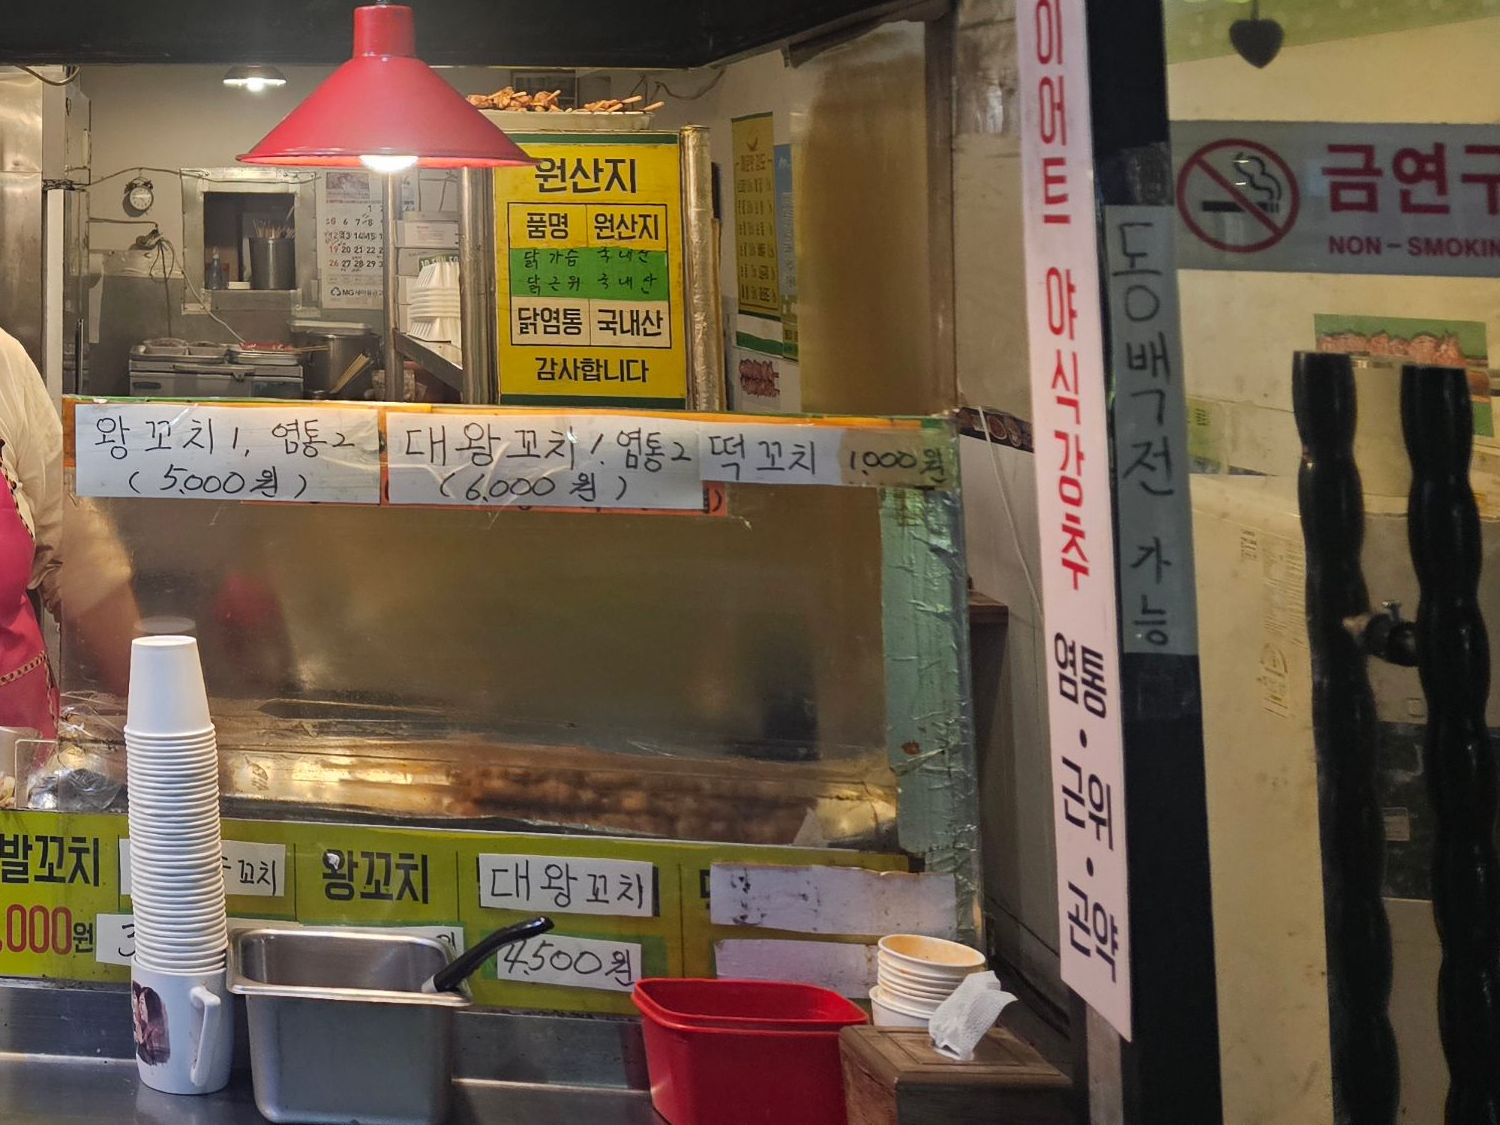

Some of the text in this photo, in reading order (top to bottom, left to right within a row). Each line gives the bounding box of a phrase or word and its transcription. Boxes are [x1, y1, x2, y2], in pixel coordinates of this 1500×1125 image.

[534, 157, 637, 195] 원산지
[526, 212, 659, 241] 품명 원산지
[329, 259, 339, 267] 26
[341, 260, 351, 268] 27
[366, 260, 376, 268] 29
[341, 246, 351, 254] 20
[366, 246, 376, 254] 22
[518, 307, 663, 338] 닭염통 국내산
[534, 357, 649, 383] 감사합니다
[1044, 266, 1090, 591] 야식강추
[1054, 631, 1107, 719] 염통
[1061, 756, 1113, 851] 근위
[322, 847, 429, 902] 왕꼬치
[490, 859, 645, 910] 대왕꼬치
[1067, 880, 1119, 983] 곤약
